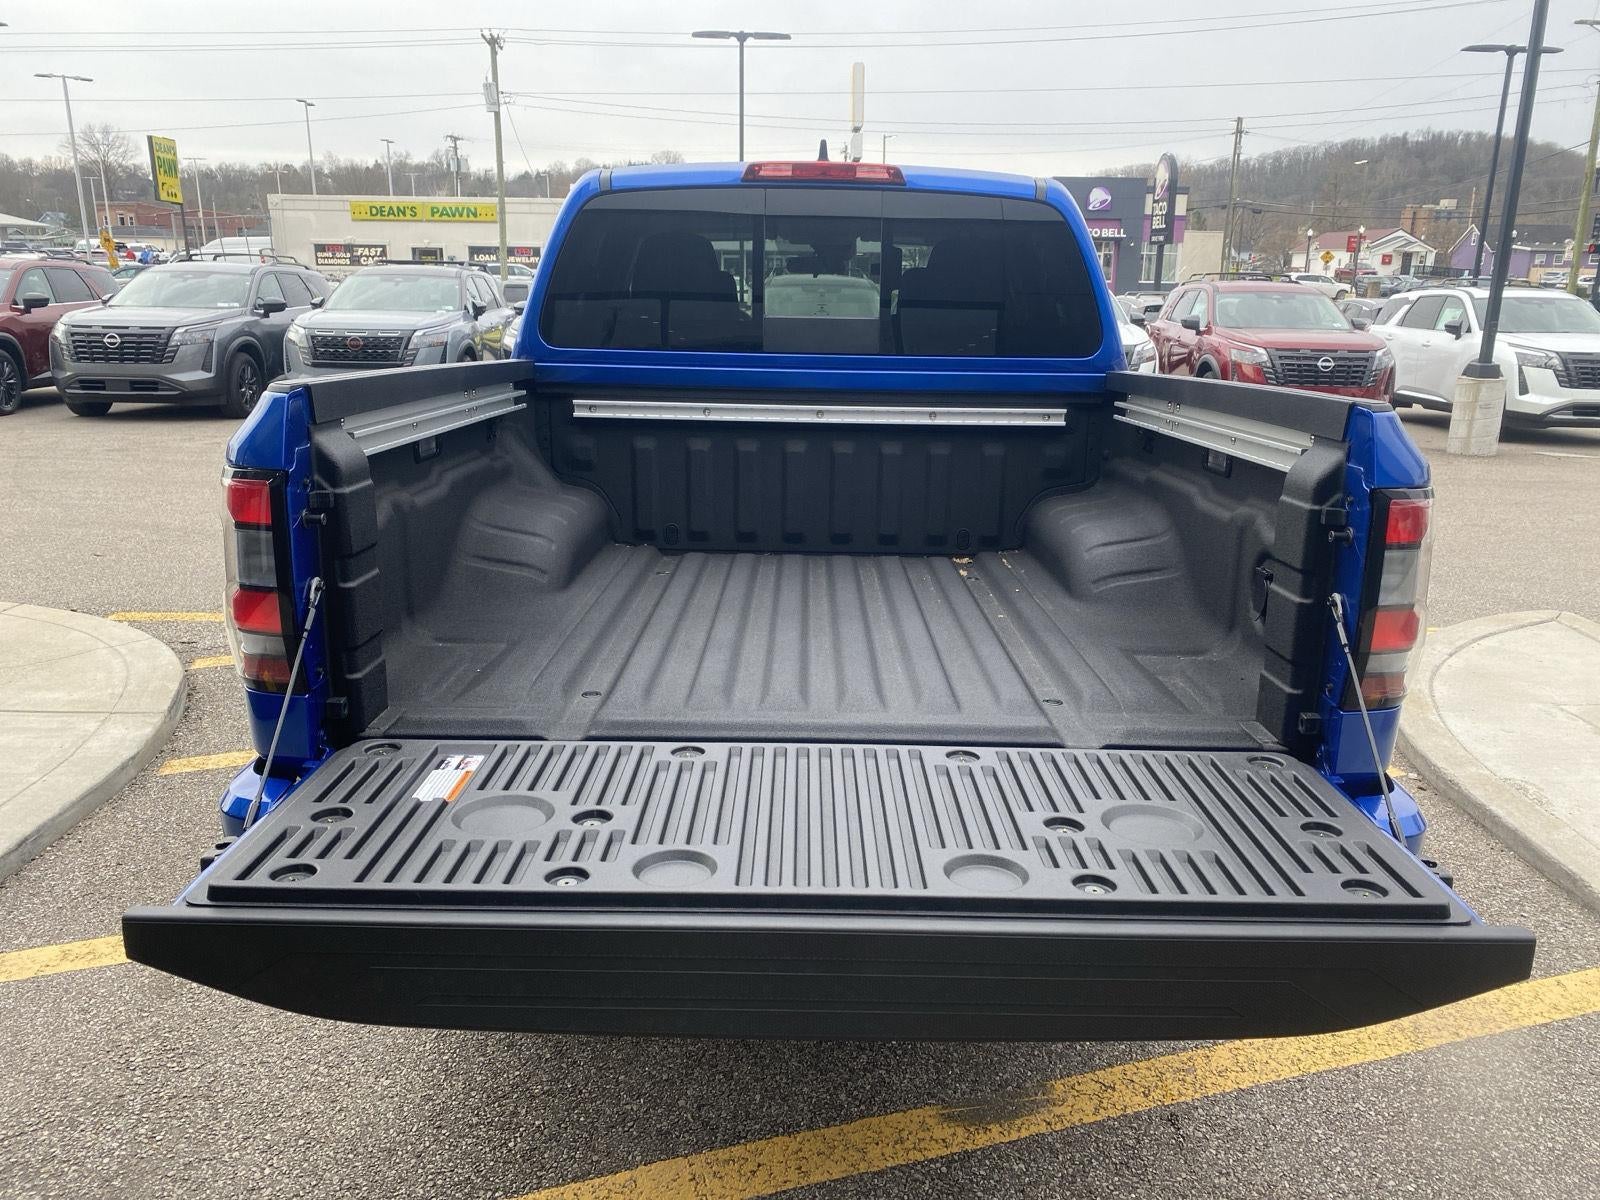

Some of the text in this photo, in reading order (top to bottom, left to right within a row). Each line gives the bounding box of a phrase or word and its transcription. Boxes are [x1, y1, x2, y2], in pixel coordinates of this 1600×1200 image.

[369, 205, 478, 219] DEAN'S PAWN
[1152, 201, 1167, 216] TACO
[1152, 215, 1166, 229] BELL
[1101, 228, 1127, 237] BELL
[357, 247, 383, 256] FAST
